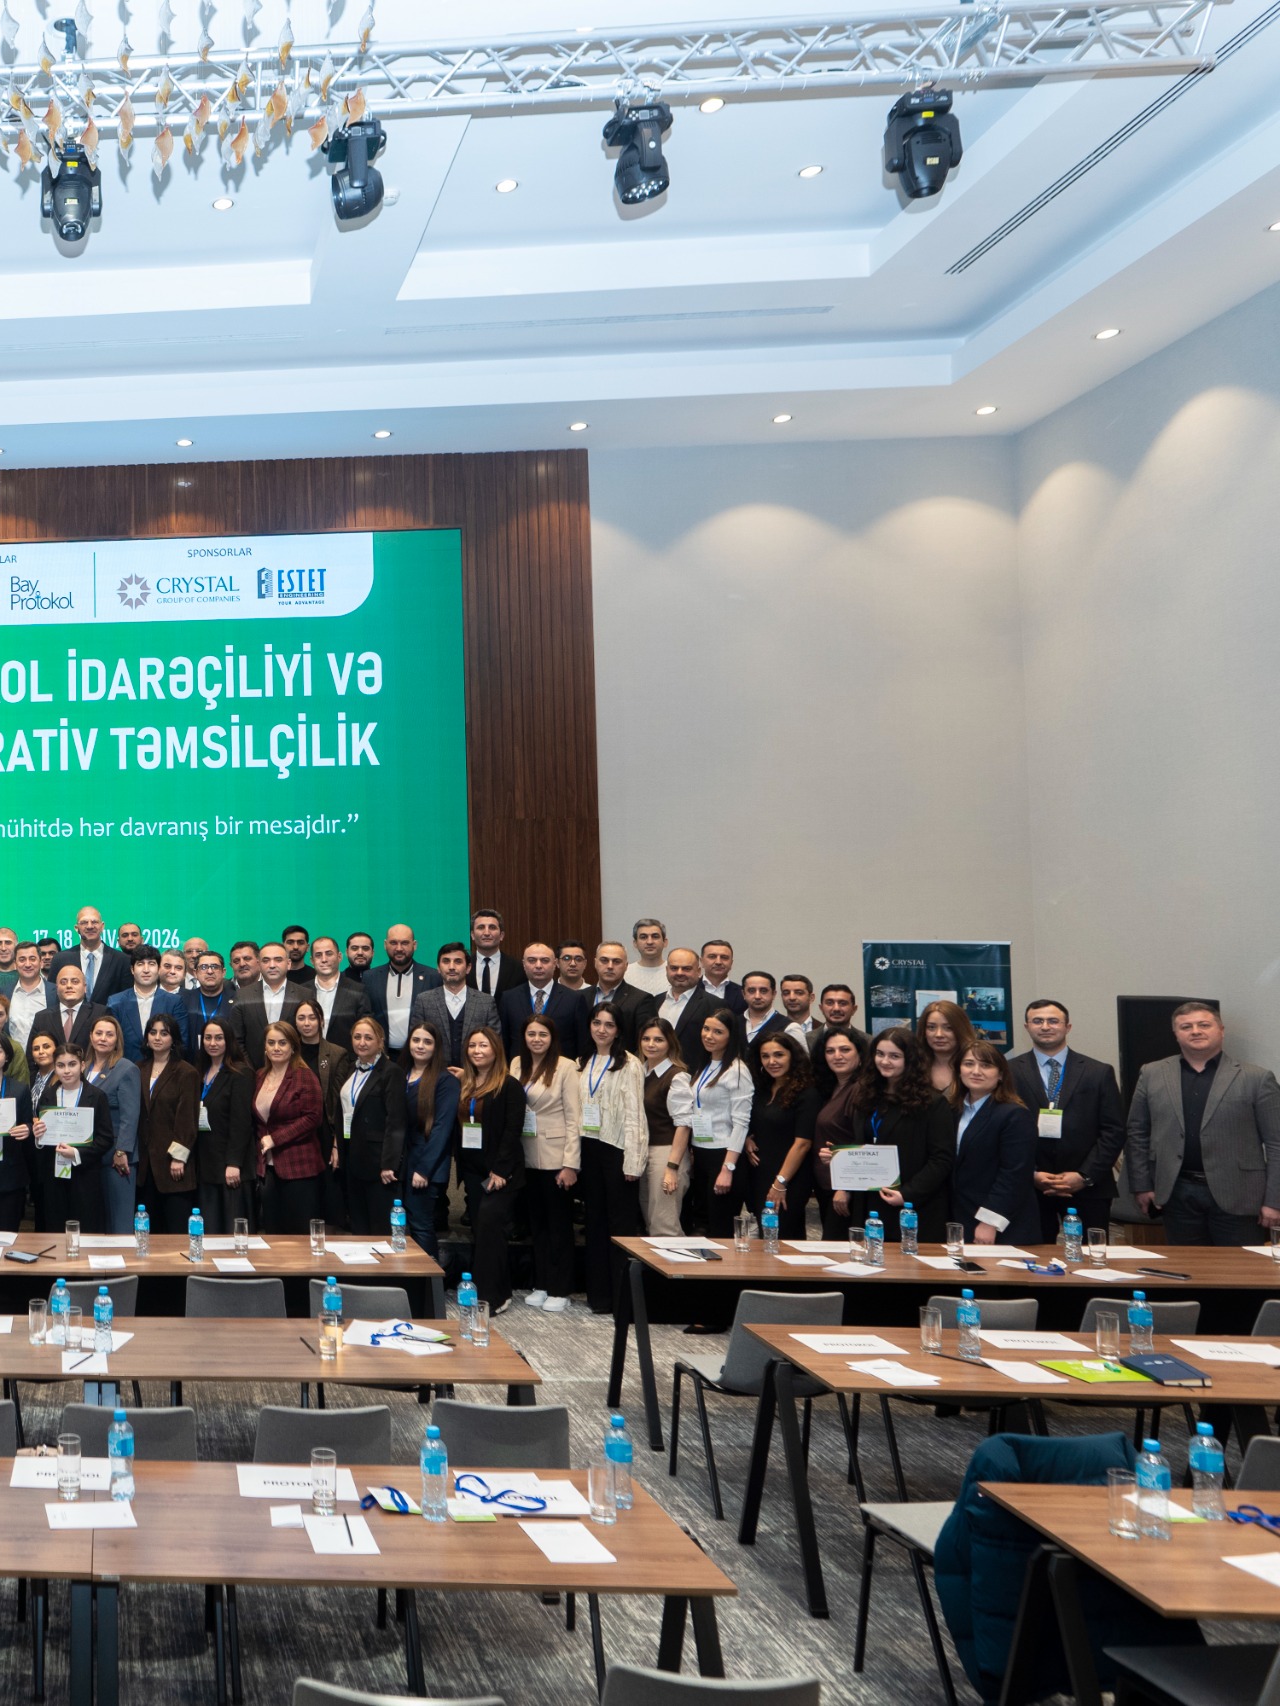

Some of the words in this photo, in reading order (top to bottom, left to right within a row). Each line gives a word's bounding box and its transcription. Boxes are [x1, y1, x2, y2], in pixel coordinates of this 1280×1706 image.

[187, 547, 252, 558] SPONSORLAR
[10, 575, 40, 593] Bay
[156, 575, 240, 594] CRYSTAL
[277, 568, 327, 592] ESTET
[10, 591, 75, 611] Protokol
[196, 595, 241, 603] COMPANIES
[67, 643, 312, 710] İDARƏÇİLİYİ
[326, 651, 383, 696] VƏ
[109, 712, 380, 779] TƏMSİLÇİLİK
[79, 817, 115, 837] hər
[120, 816, 209, 842] davranış
[215, 815, 243, 835] bir
[142, 928, 180, 949] 2026
